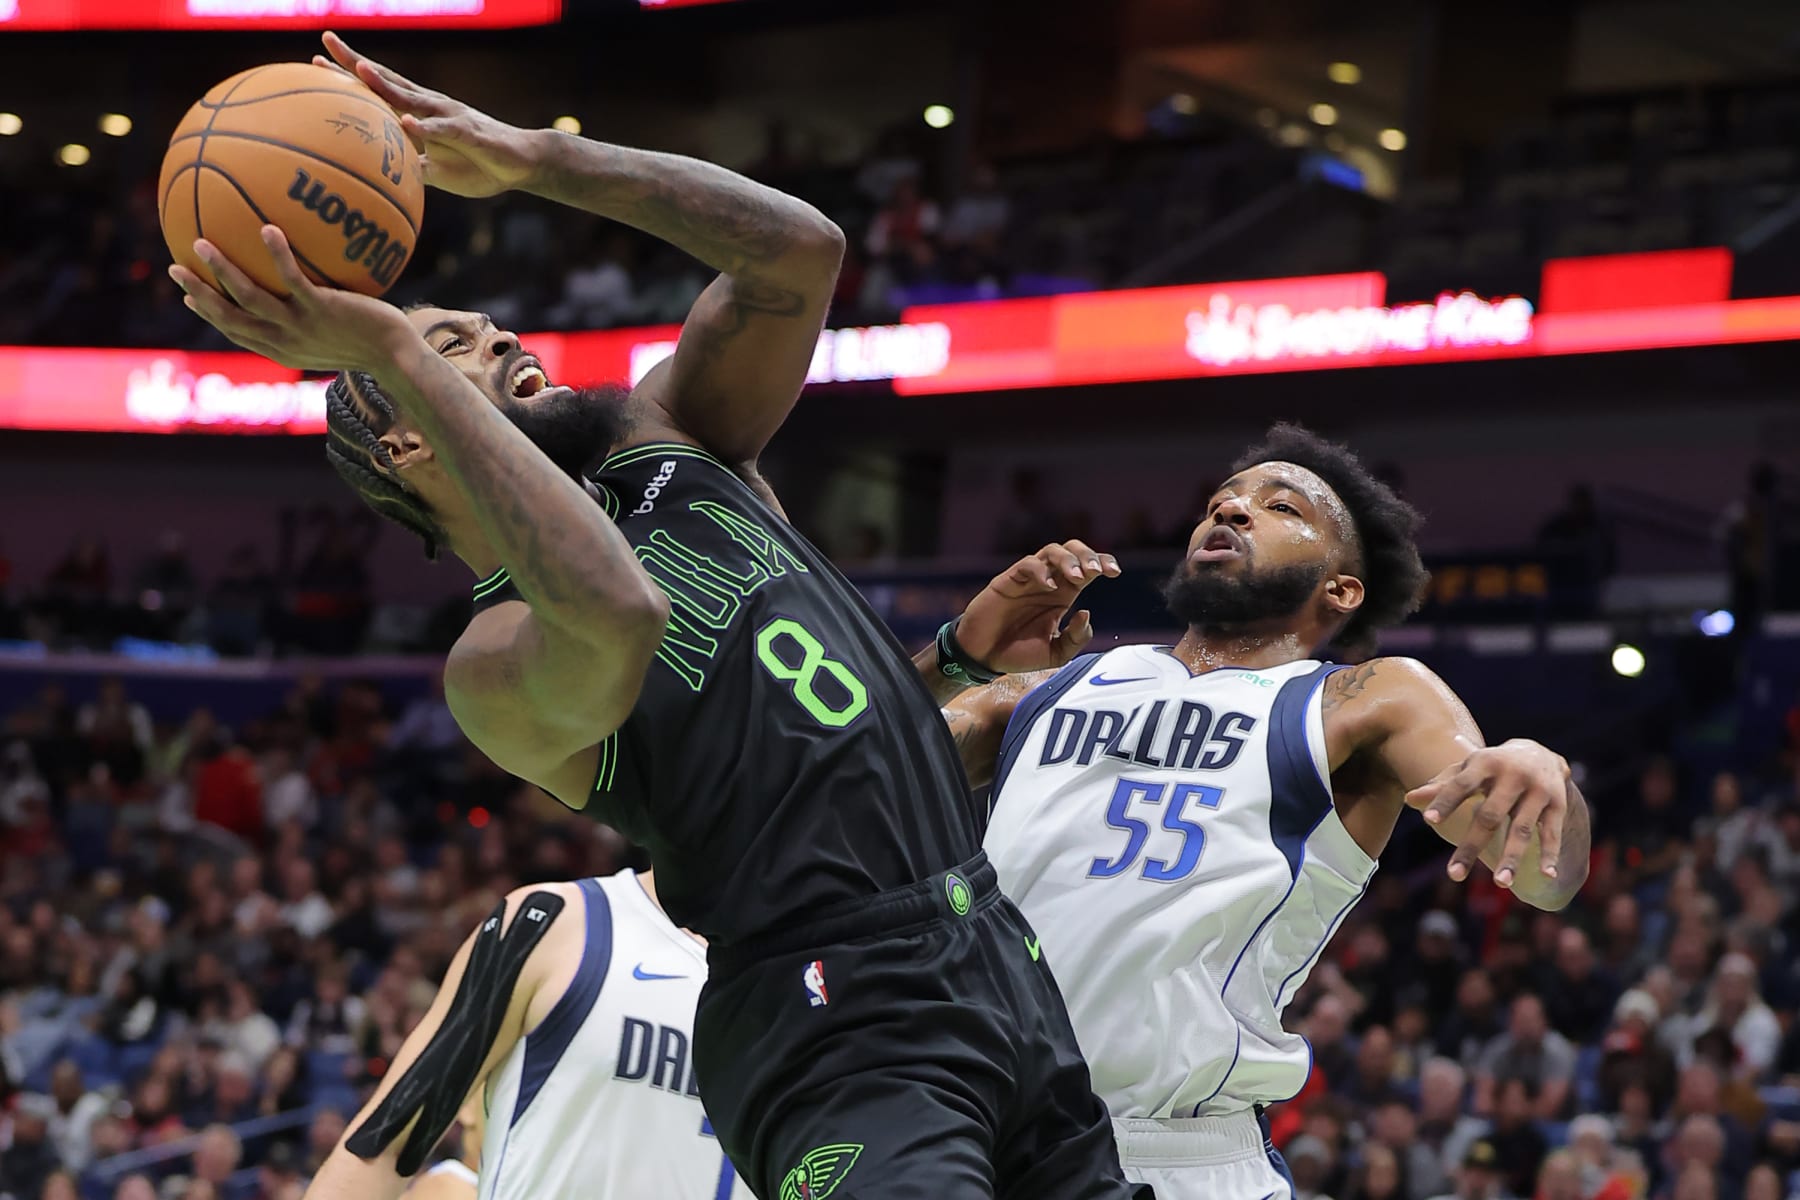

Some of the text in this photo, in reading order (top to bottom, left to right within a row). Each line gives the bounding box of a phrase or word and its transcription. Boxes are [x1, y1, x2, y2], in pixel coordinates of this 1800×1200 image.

[287, 167, 408, 287] Wilson
[633, 500, 809, 692] NOLA
[755, 615, 872, 728] 8
[1037, 699, 1257, 771] DALLAS
[1085, 776, 1226, 883] 55
[611, 1014, 701, 1100] DA
